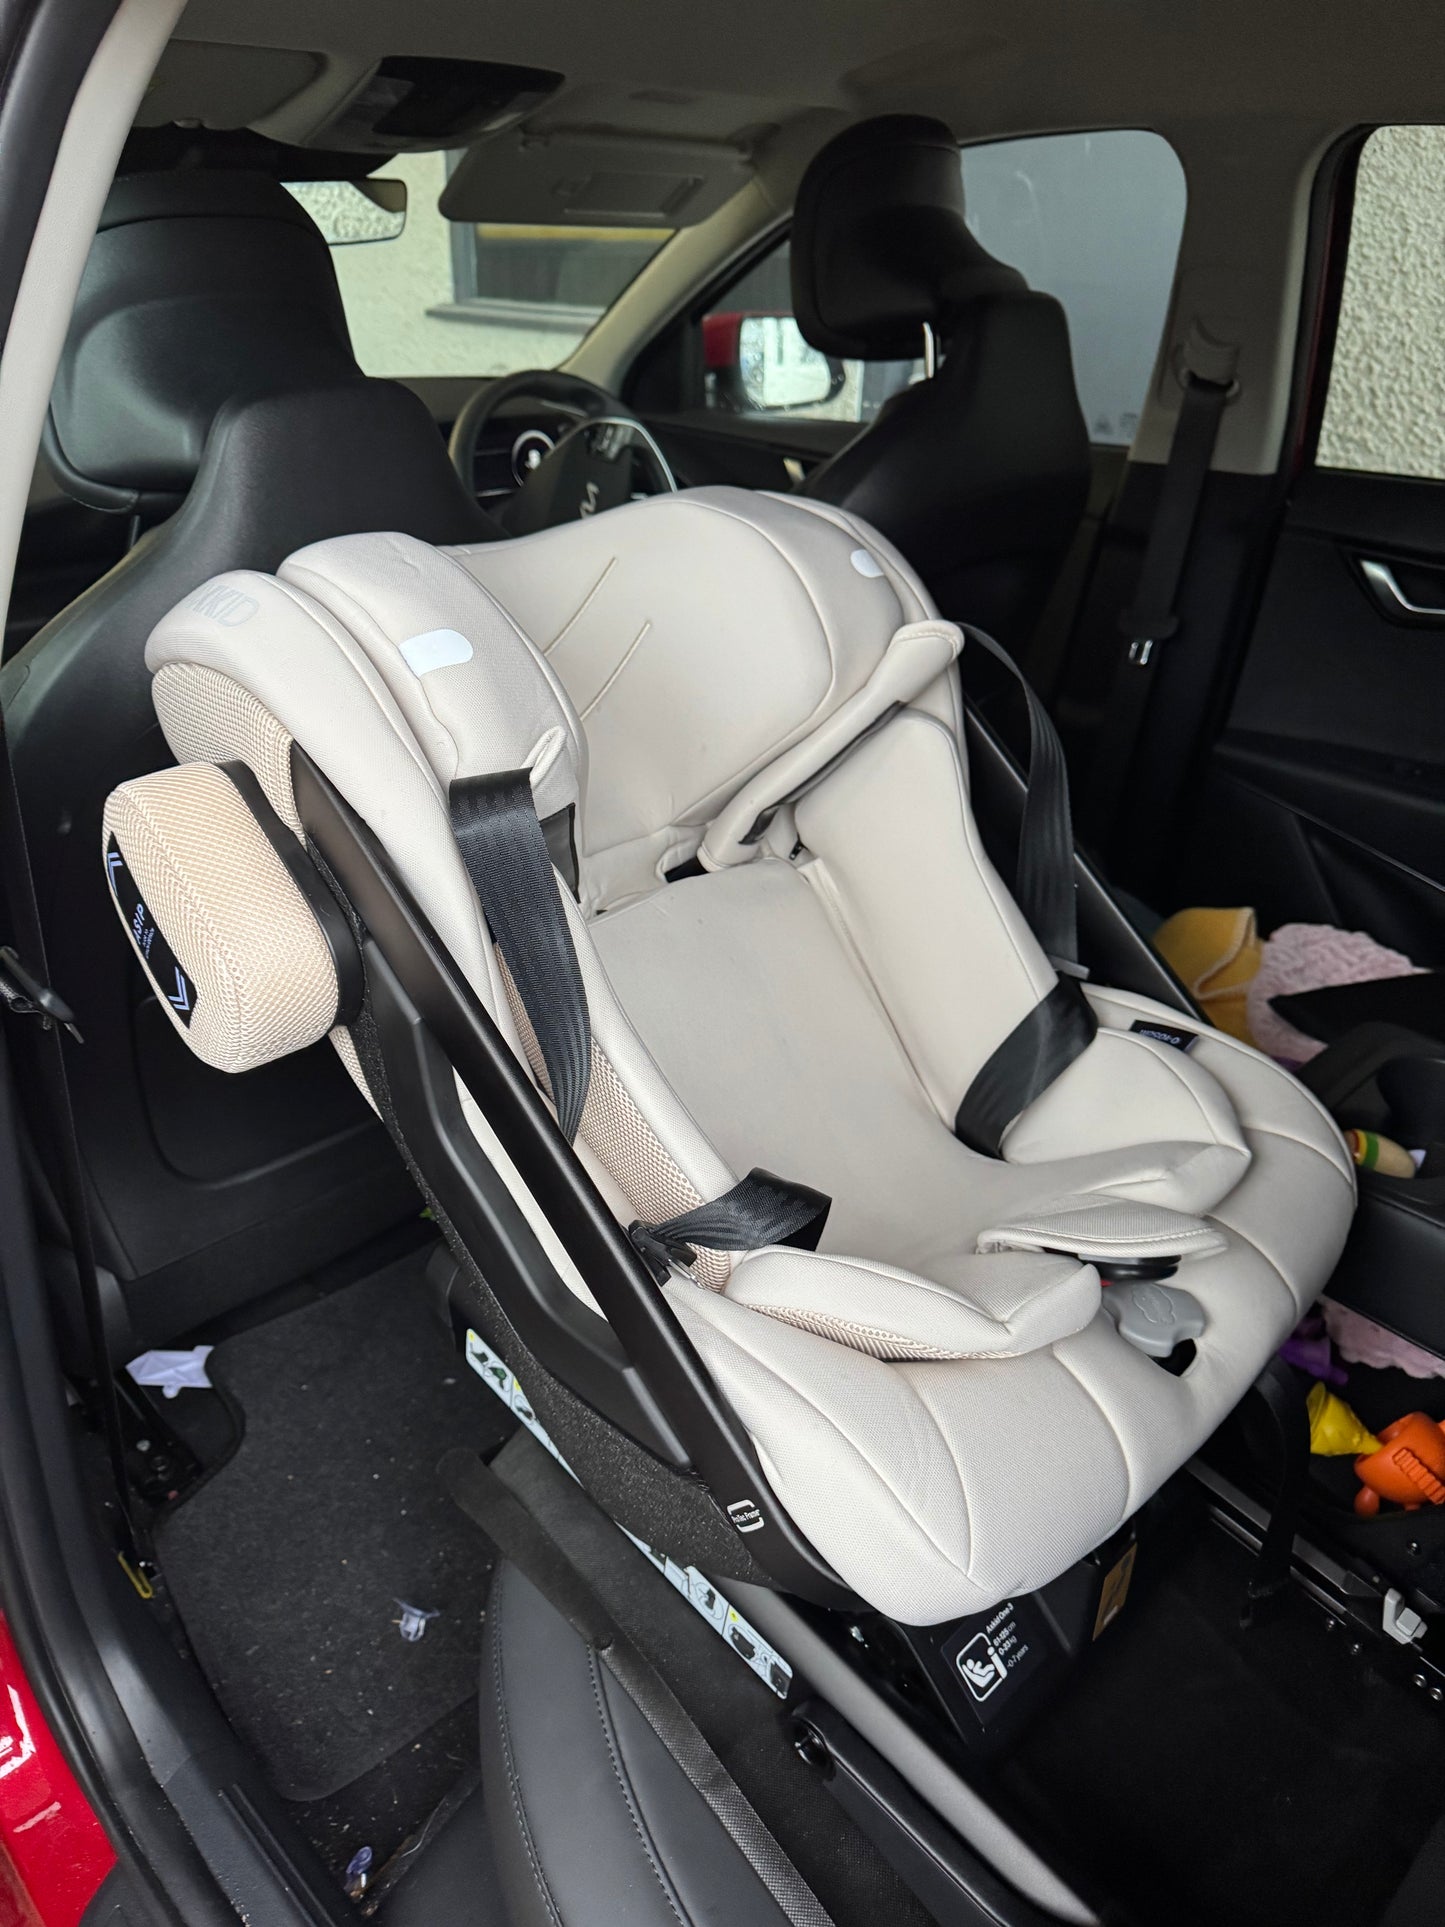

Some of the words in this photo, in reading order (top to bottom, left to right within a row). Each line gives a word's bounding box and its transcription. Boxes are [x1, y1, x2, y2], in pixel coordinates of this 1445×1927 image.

[133, 903, 145, 946] ASIP
[998, 1607, 1010, 1620] One
[1015, 1644, 1029, 1661] years
